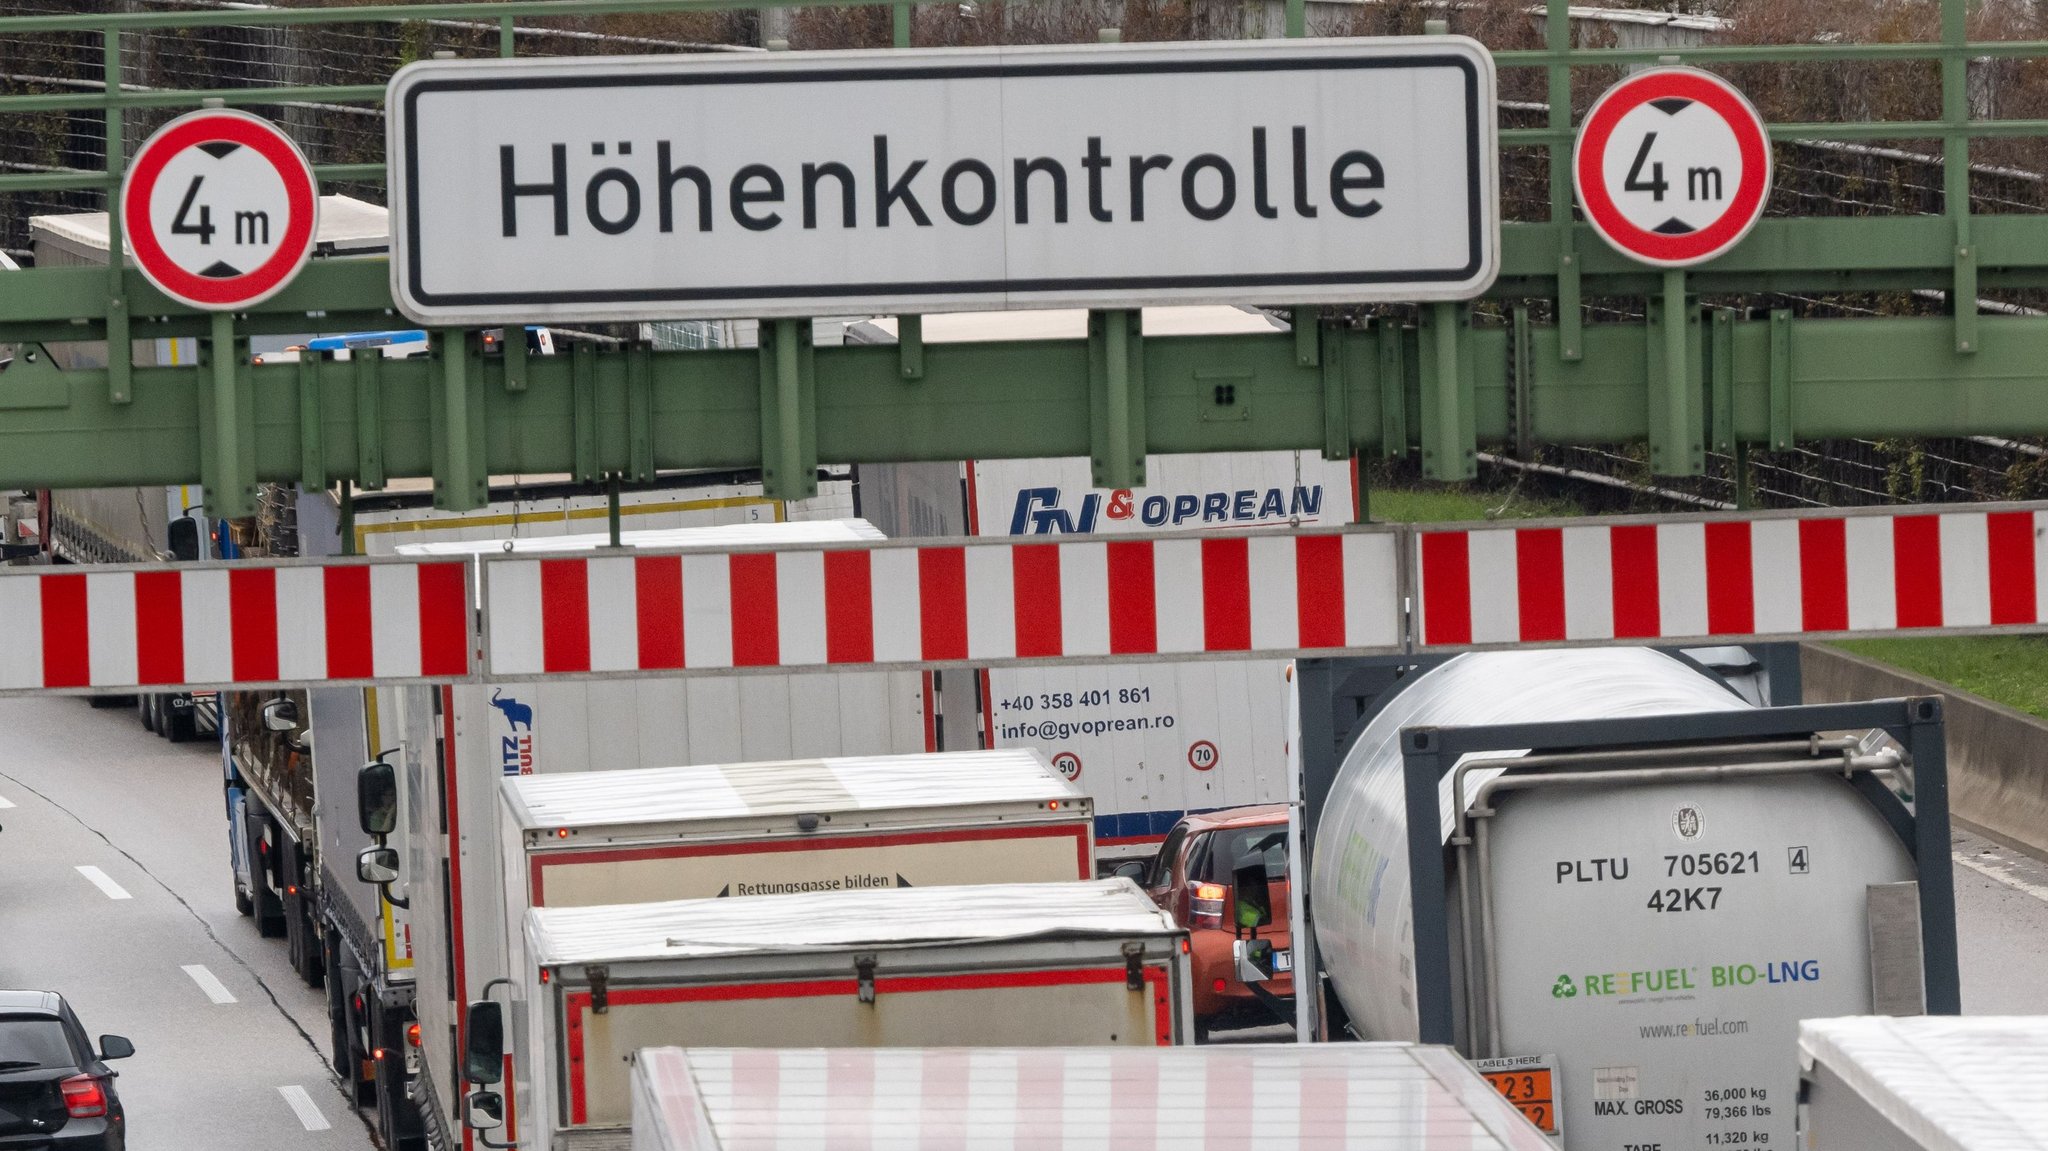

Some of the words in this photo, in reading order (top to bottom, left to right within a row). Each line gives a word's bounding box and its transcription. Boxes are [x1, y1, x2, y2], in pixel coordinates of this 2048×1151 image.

[1624, 132, 1668, 201] 4
[1688, 167, 1722, 200] m
[499, 126, 1386, 238] Höhenkontrolle
[171, 175, 215, 244] 4
[235, 211, 268, 244] m
[752, 509, 758, 520] 5
[1106, 489, 1134, 520] &
[1141, 485, 1322, 526] OPREAN
[1001, 696, 1034, 711] +40
[1040, 693, 1073, 709] 358
[1079, 690, 1111, 706] 401
[1119, 687, 1151, 703] 861
[1002, 714, 1174, 740] info@gvoprean.ro
[1059, 761, 1075, 773] 50
[1196, 750, 1211, 762] 70
[1556, 857, 1629, 883] PLTU
[1664, 851, 1760, 877] 705621
[1791, 849, 1806, 871] 4
[738, 878, 840, 896] Rettungsgasse
[845, 874, 889, 889] bilden
[1647, 887, 1722, 912] 42K7
[1711, 960, 1820, 988] BIO-LNG
[1639, 1018, 1749, 1040] www.reefuel.com
[1477, 1058, 1513, 1068] LABELS
[1516, 1056, 1541, 1064] HERE
[1704, 1088, 1746, 1102] 36,000
[1751, 1087, 1767, 1100] kg
[1594, 1101, 1629, 1116] MAX.
[1634, 1099, 1683, 1115] GROSS
[1705, 1106, 1747, 1120] 79,366
[1752, 1105, 1771, 1116] lbs
[1706, 1132, 1748, 1146] 11,320
[1753, 1131, 1769, 1144] kg
